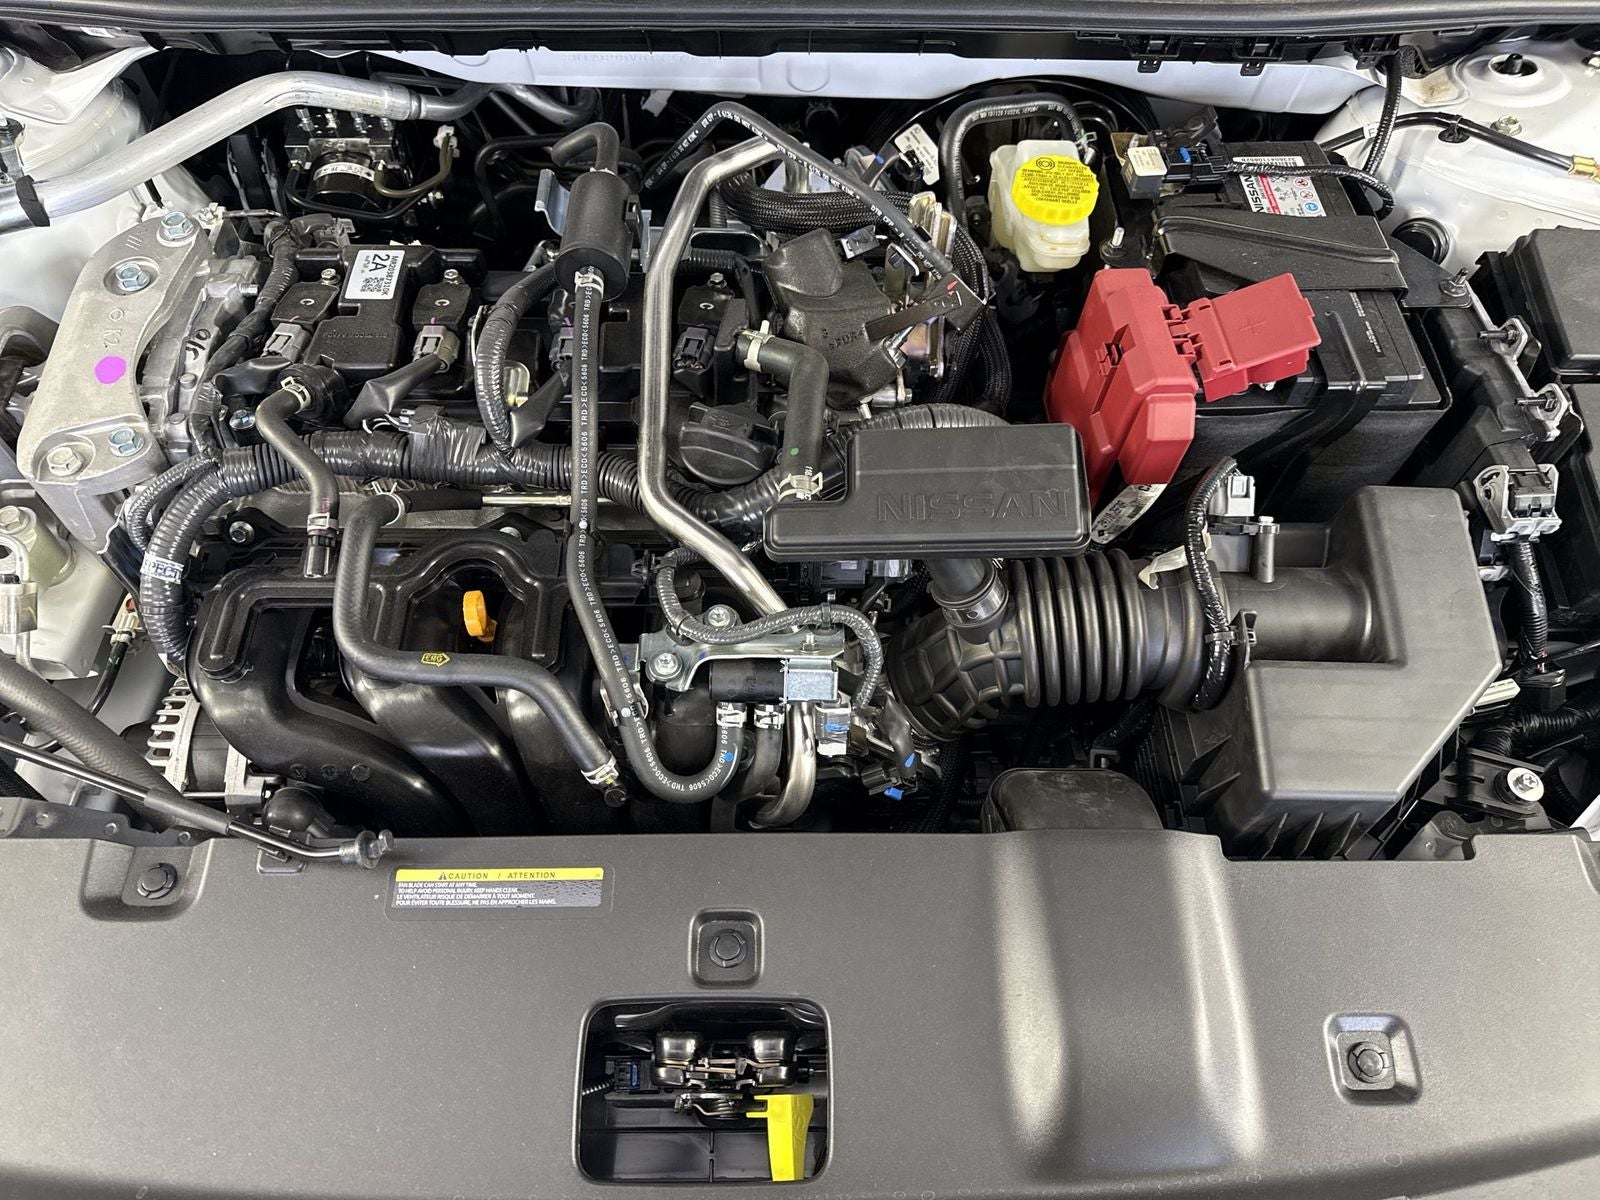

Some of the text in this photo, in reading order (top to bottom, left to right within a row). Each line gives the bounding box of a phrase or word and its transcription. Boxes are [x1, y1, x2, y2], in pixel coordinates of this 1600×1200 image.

[369, 253, 390, 272] 2A
[300, 298, 315, 306] C
[434, 299, 450, 307] C
[700, 302, 714, 310] C
[877, 490, 1068, 521] NISSAN
[448, 872, 488, 880] CAUTION
